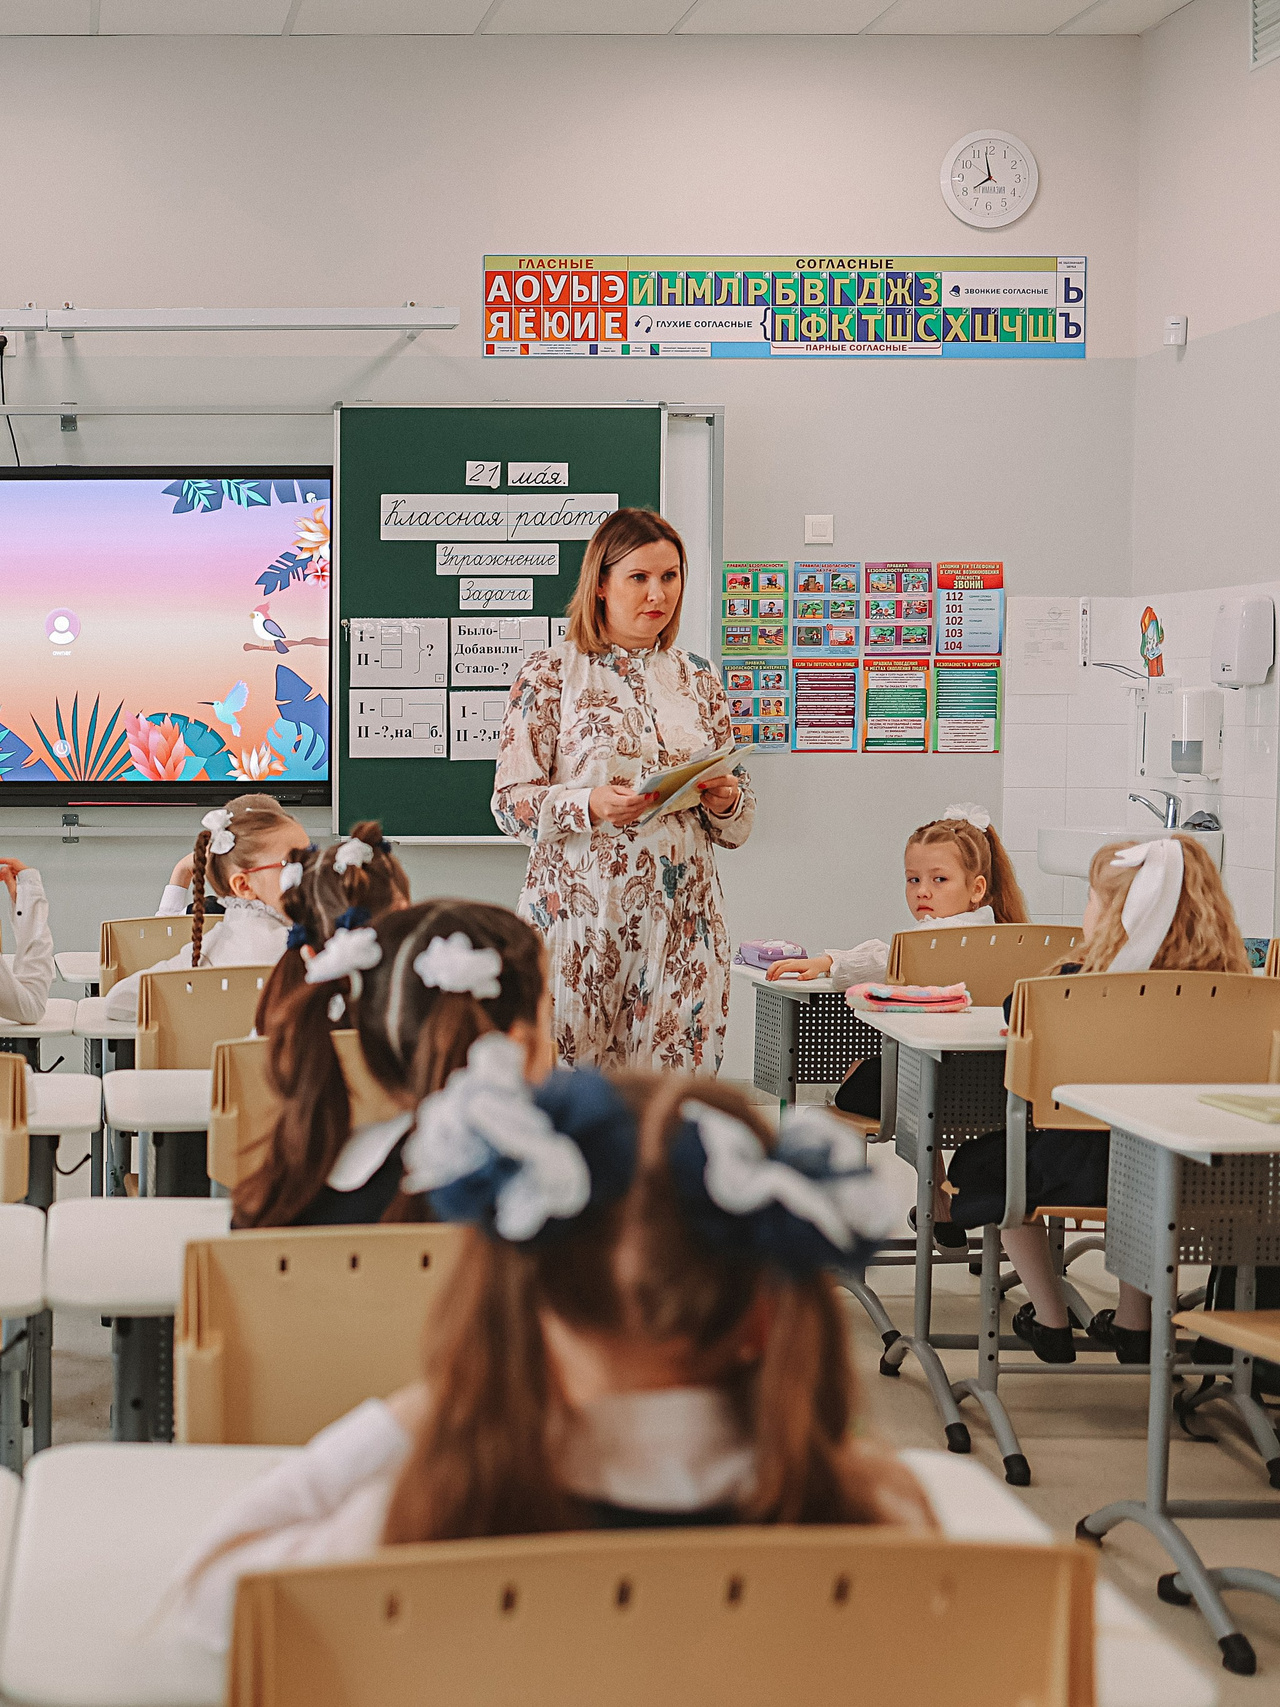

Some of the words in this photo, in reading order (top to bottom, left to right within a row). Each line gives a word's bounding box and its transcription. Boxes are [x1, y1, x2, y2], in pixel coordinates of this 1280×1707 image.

[519, 259, 594, 269] ГЛАСНЫЕ
[796, 259, 894, 269] СОГЛАСНЫЕ
[1065, 278, 1083, 303] Ь
[656, 320, 691, 328] ГЛУХИЕ
[694, 320, 752, 328] СОГЛАСНЫЕ
[1059, 312, 1081, 338] Ъ
[806, 344, 846, 352] ПАРНЫЕ
[850, 344, 907, 352] СОГЛАСНЫЕ
[470, 464, 499, 482] 21
[385, 499, 504, 526] Классная
[439, 546, 556, 574] Упражнение
[954, 581, 983, 589] ЗВОНИ!
[462, 581, 530, 608] Задача
[946, 592, 963, 600] 112
[946, 605, 963, 613] 101
[946, 617, 963, 625] 102
[945, 629, 962, 637] 103
[427, 644, 433, 656] ?
[944, 641, 962, 650] 104
